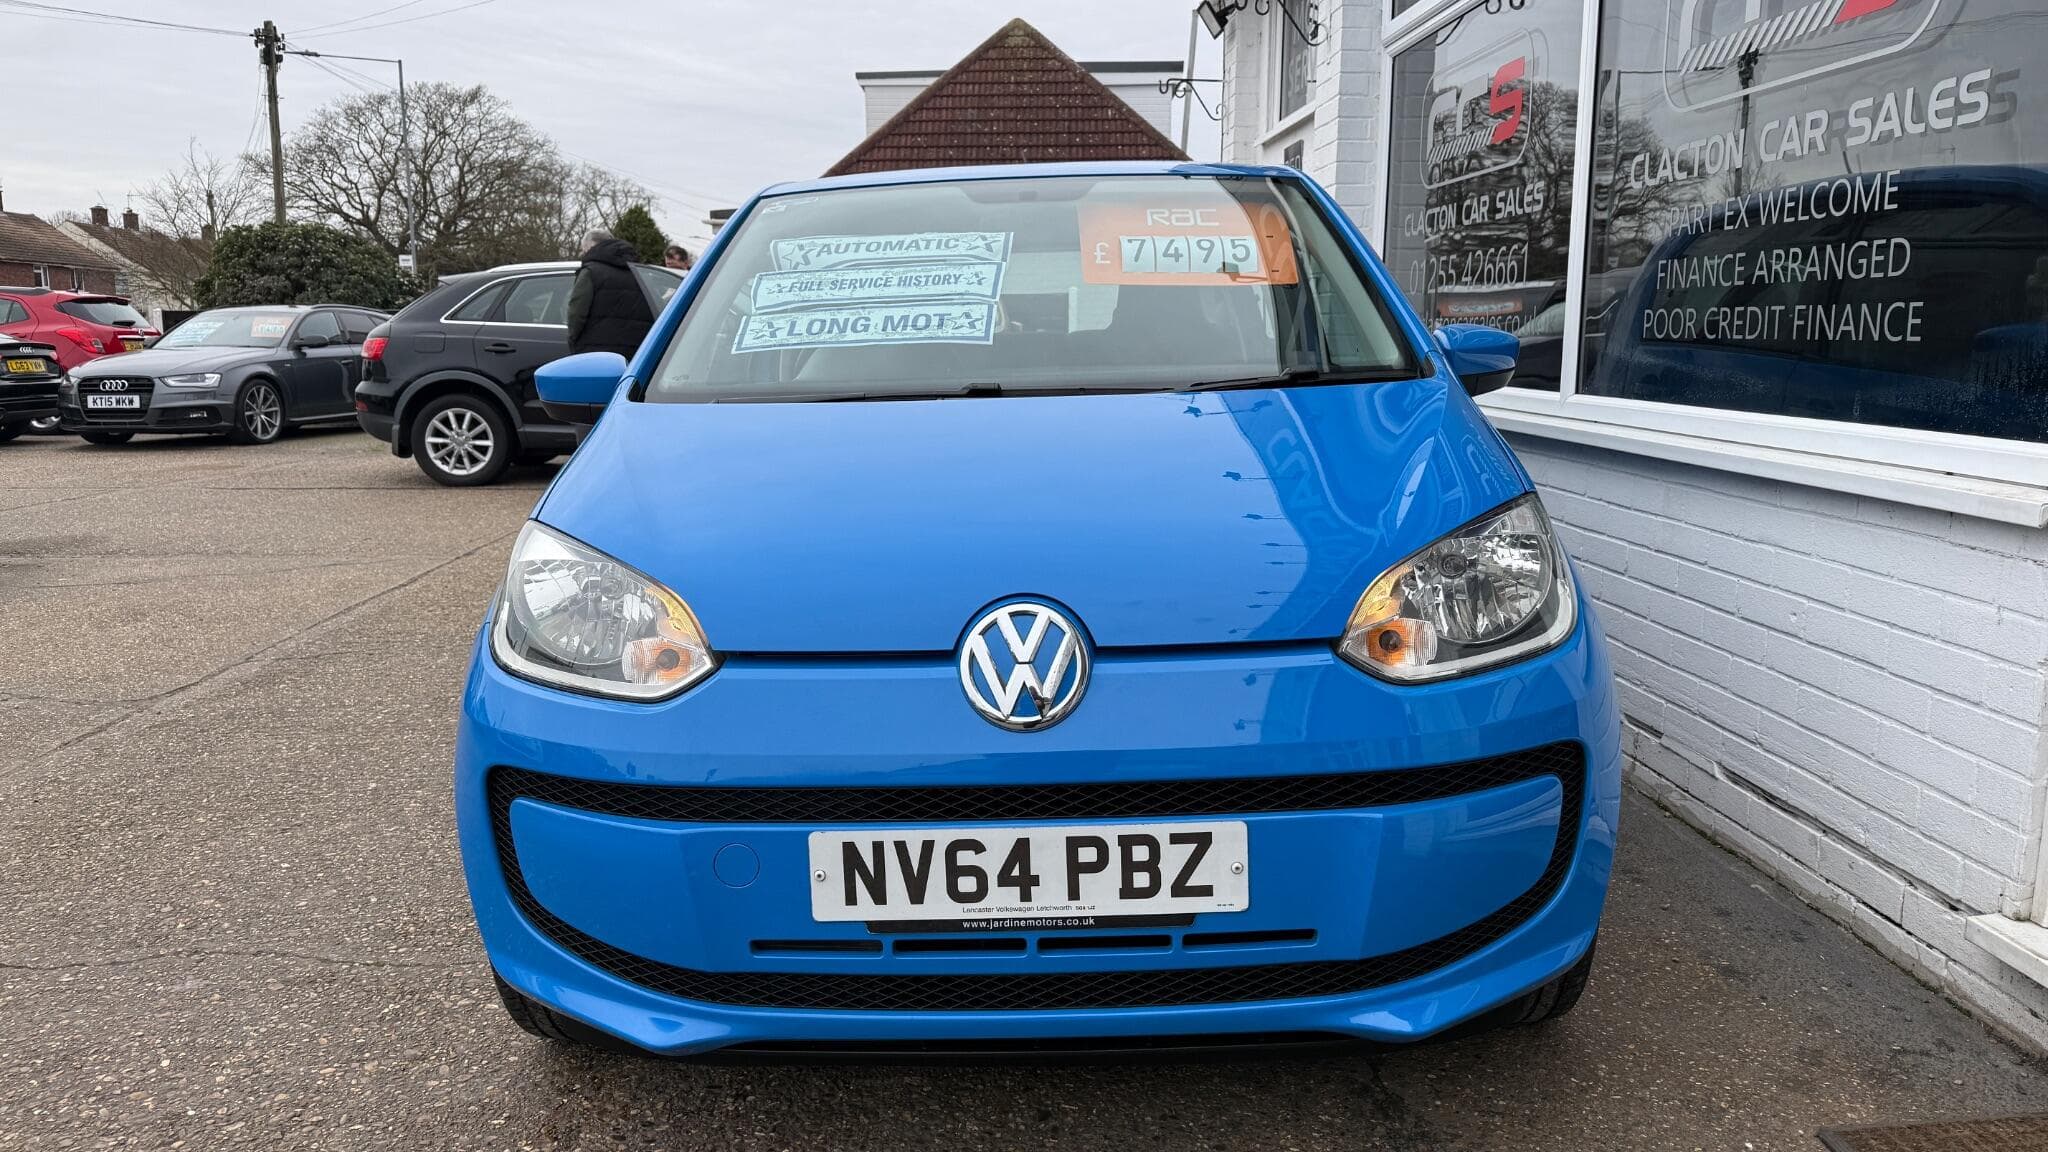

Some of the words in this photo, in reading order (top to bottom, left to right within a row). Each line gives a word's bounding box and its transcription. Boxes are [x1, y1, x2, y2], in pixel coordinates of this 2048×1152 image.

[1630, 129, 1745, 189] CLACTON
[1759, 109, 1830, 163] CAR
[1845, 68, 1992, 147] SALES
[1404, 203, 1457, 237] CLACTON
[1462, 195, 1490, 226] CAR
[1495, 181, 1545, 220] SALES
[1668, 201, 1717, 238] PART
[1723, 195, 1751, 231] EX
[1758, 170, 1901, 226] WELCOME
[815, 238, 961, 258] AUTOMATIC
[1656, 252, 1746, 290] FINANCE
[1752, 237, 1911, 285] ARRANGED
[788, 279, 825, 293] FULL
[829, 276, 892, 291] SERVICE
[897, 273, 963, 288] HISTORY
[1409, 254, 1457, 296] 01255
[1462, 242, 1529, 289] 426661
[786, 316, 871, 337] LONG
[881, 312, 952, 333] MOT
[1643, 307, 1697, 339] POOR
[1703, 305, 1785, 340] CREDIT
[1792, 301, 1925, 342] FINANCE
[92, 396, 113, 407] KT15
[841, 837, 1041, 906] NV64
[1065, 831, 1215, 902] PBZ
[962, 906, 995, 914] Lancaster
[996, 905, 1035, 914] Volkswagen
[1036, 904, 1073, 912] Letchworth
[962, 916, 1095, 929] www.jardinemotors.co.uk
